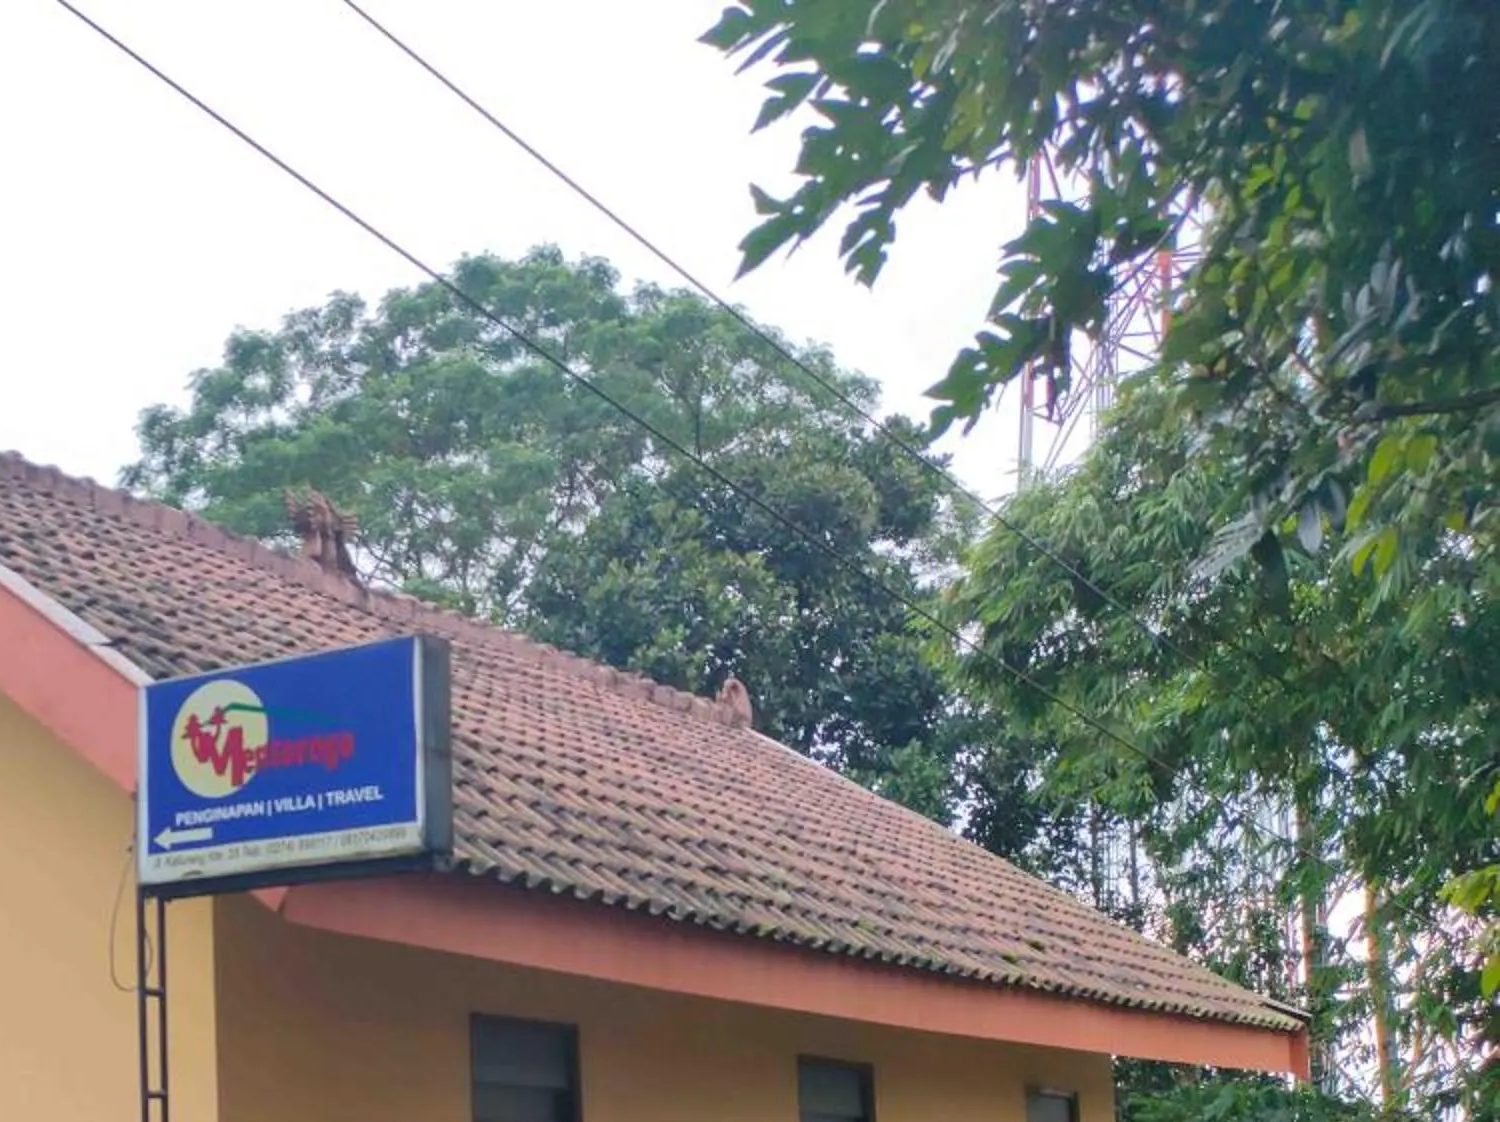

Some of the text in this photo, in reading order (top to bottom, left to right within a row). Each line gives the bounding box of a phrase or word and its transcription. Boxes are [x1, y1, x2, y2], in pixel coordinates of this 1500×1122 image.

[174, 800, 265, 826] PENGINAPAN
[273, 793, 316, 813] VILLA
[325, 785, 384, 807] TRAVEL
